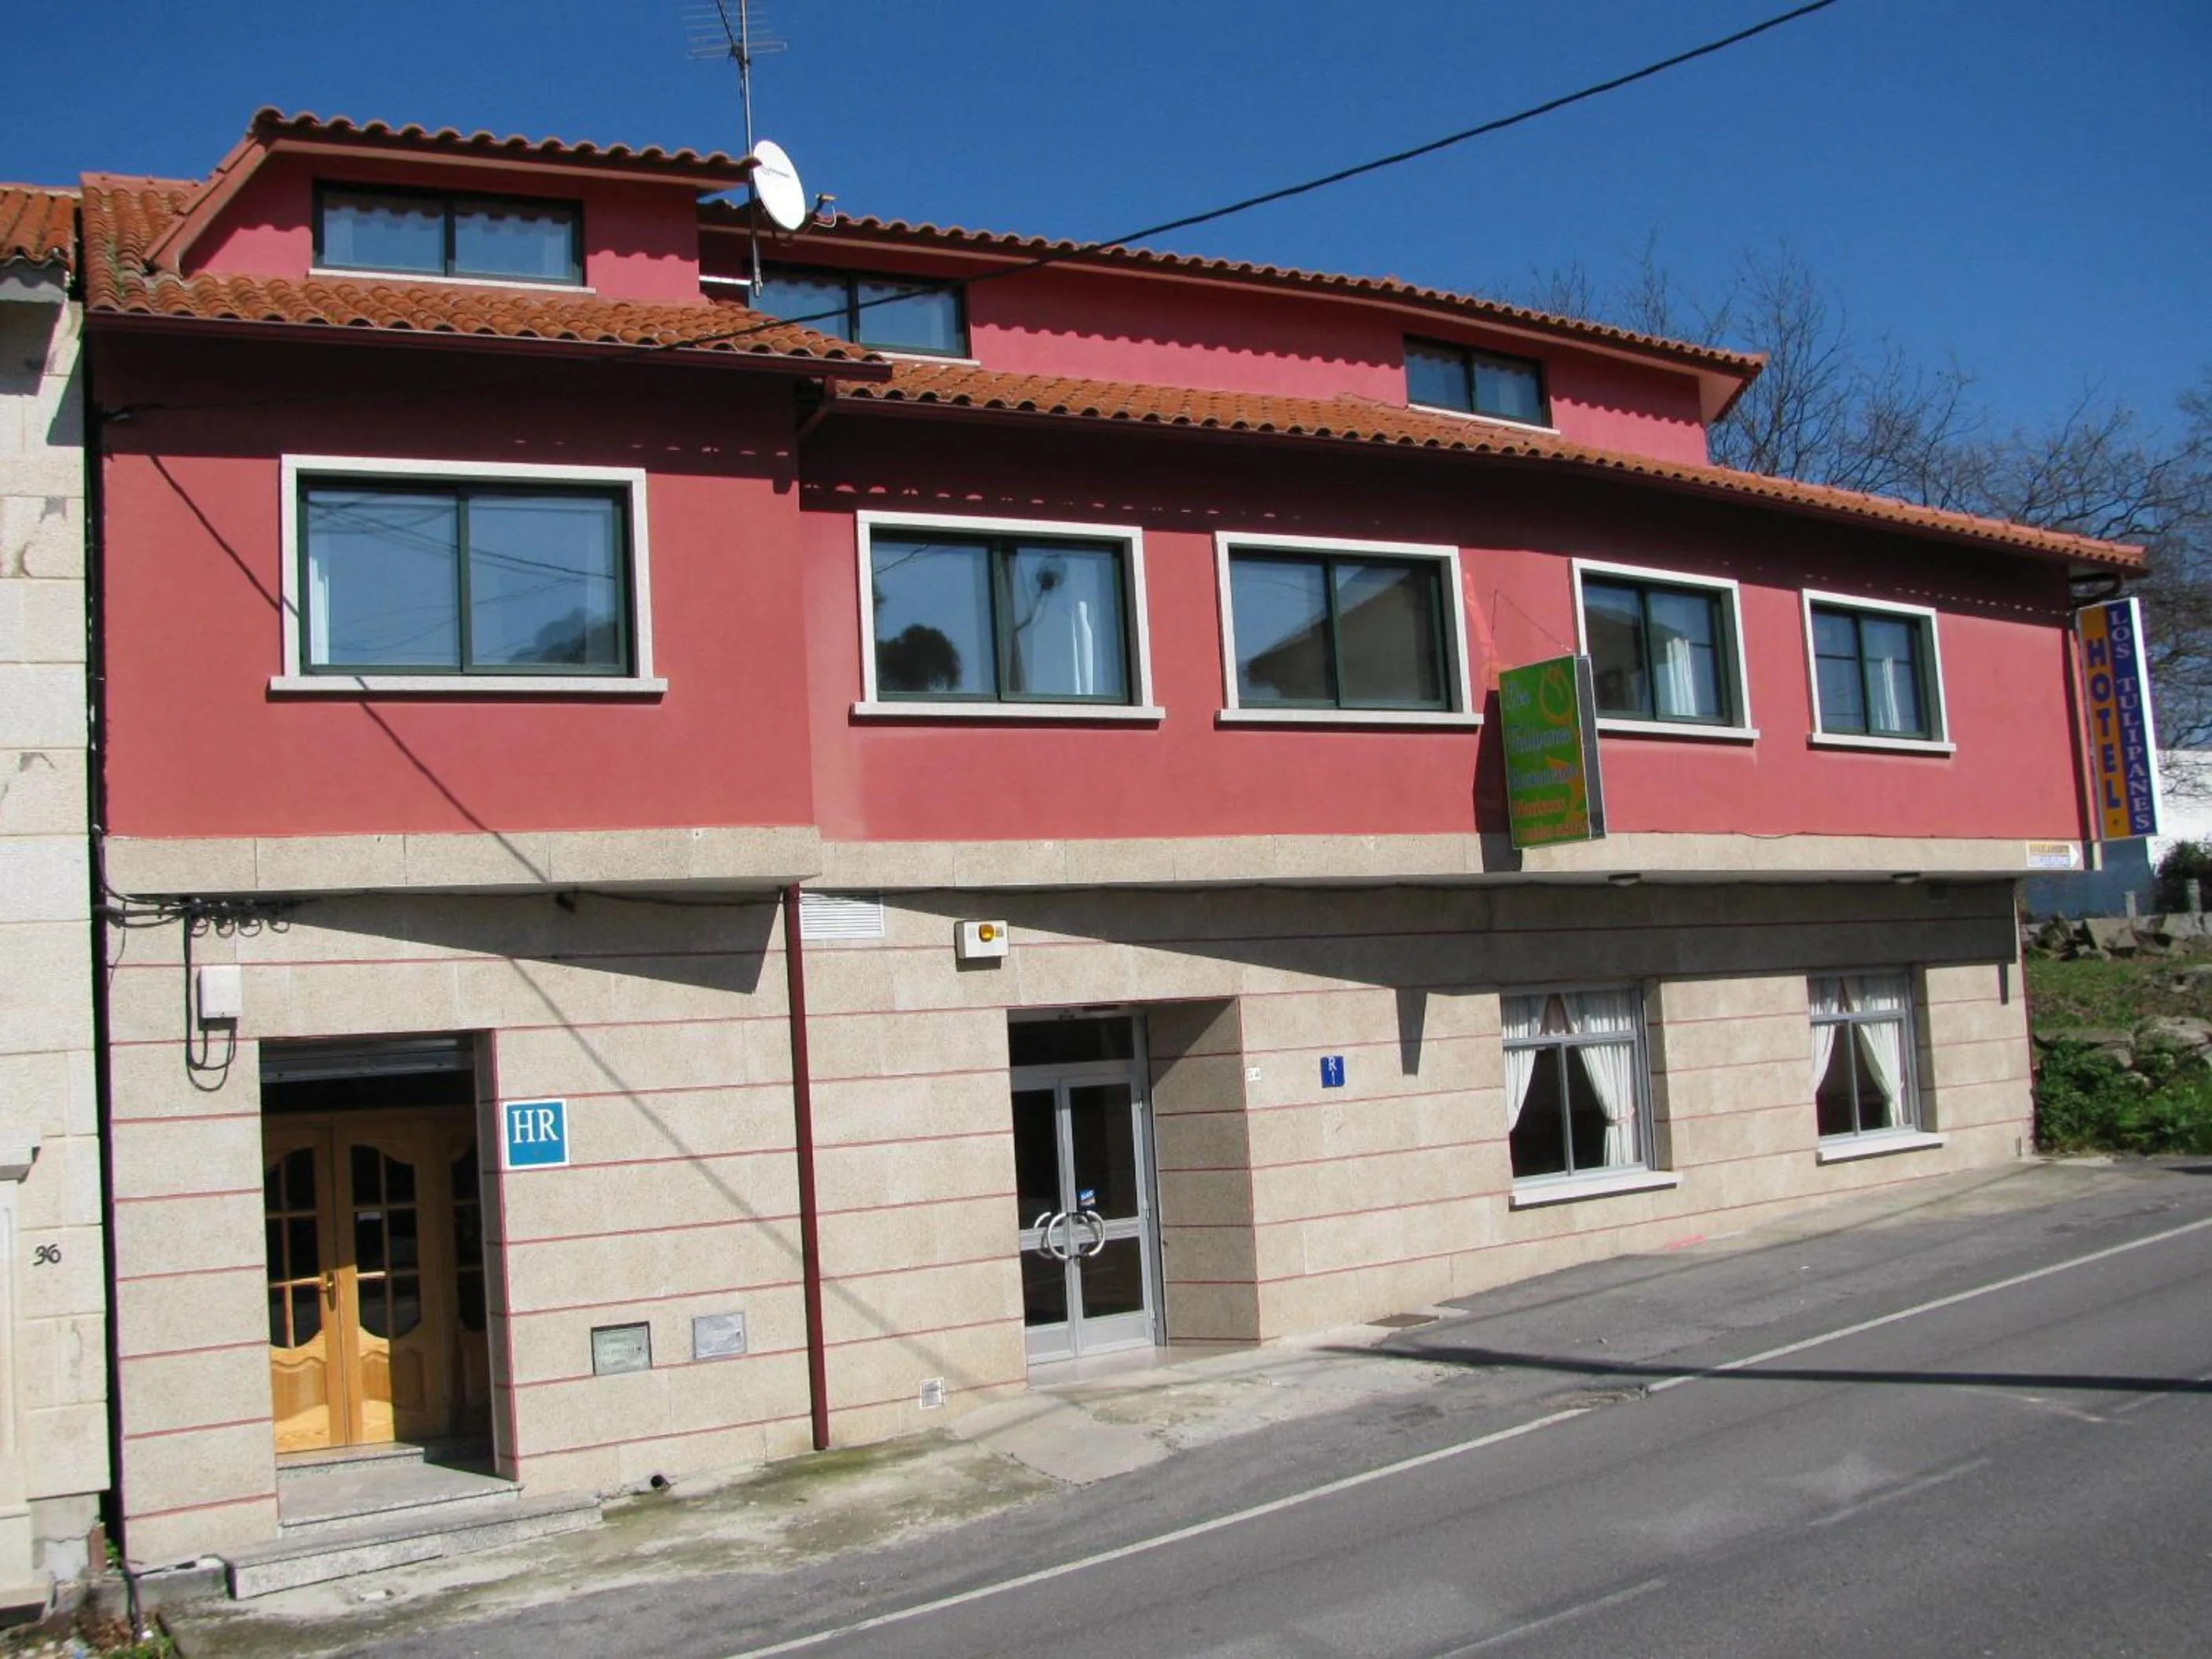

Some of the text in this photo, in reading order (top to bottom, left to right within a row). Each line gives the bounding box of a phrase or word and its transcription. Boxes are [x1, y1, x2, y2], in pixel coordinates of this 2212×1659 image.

[2086, 637, 2121, 809] HOTEL
[2110, 610, 2151, 830] LOS TULIPANES
[511, 1108, 559, 1144] HR
[33, 1243, 61, 1266] 36
